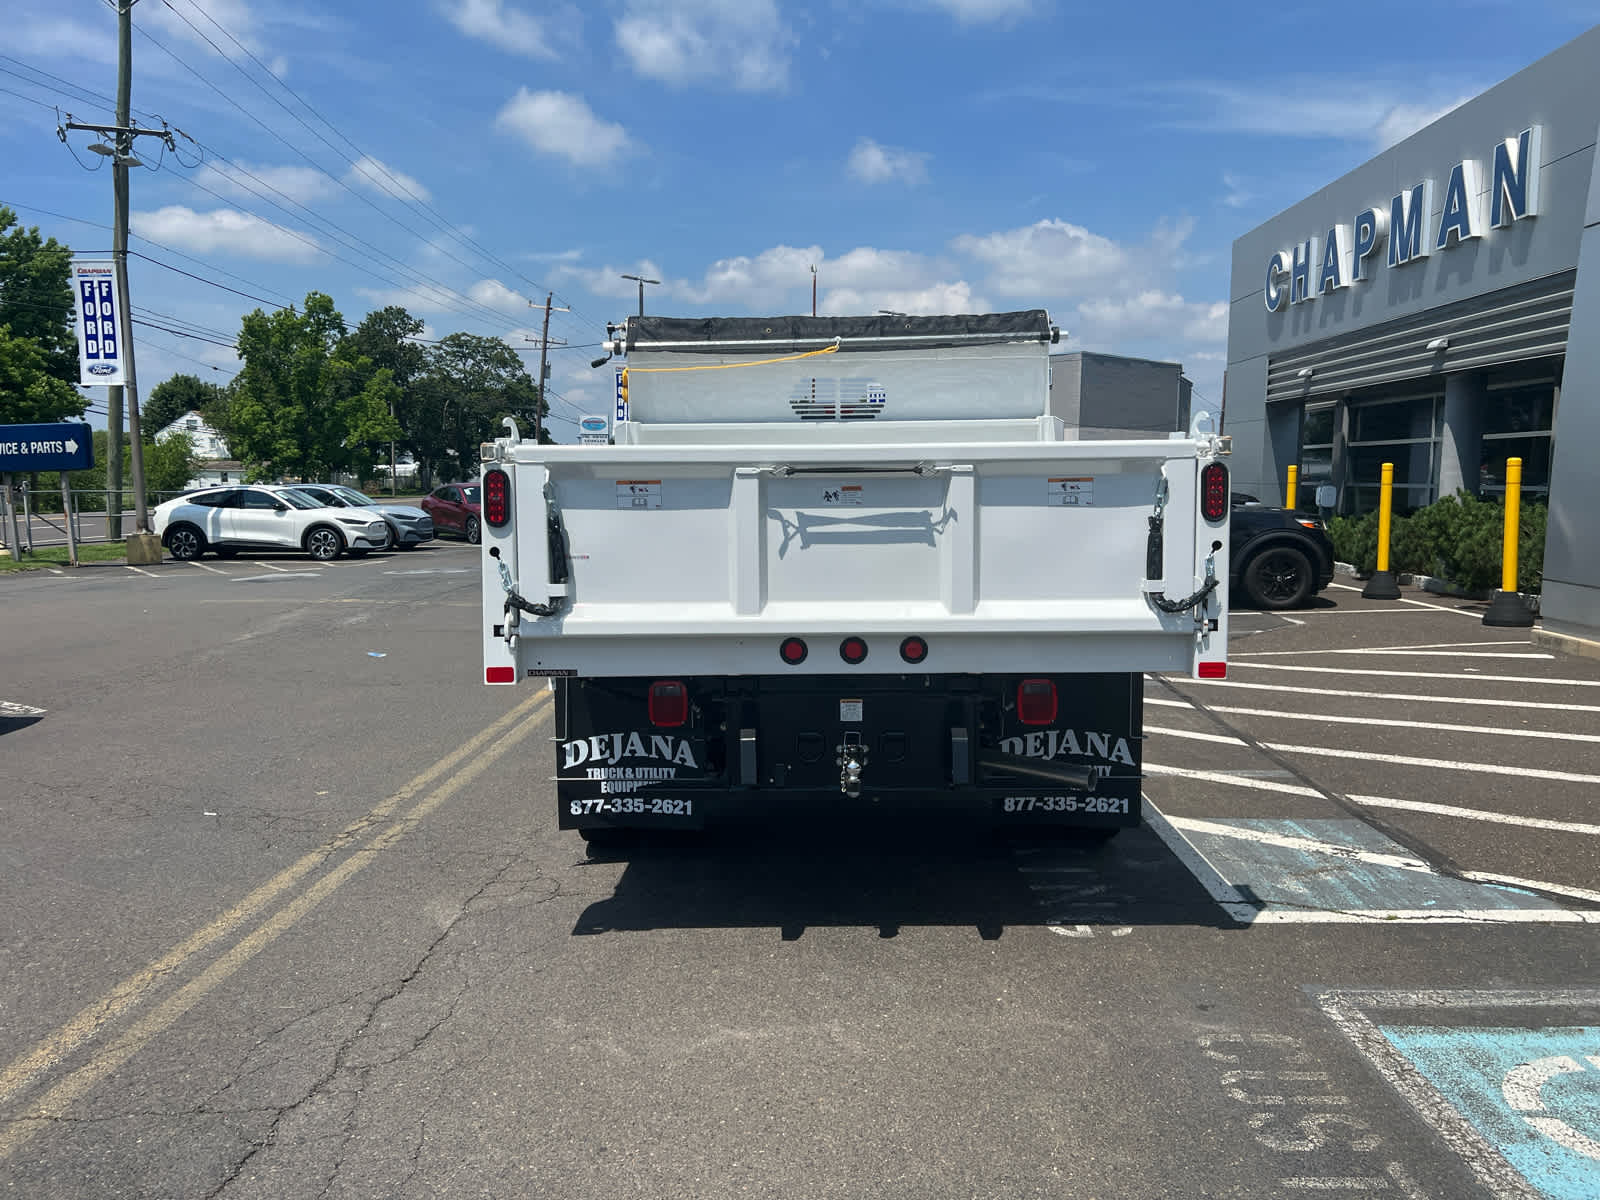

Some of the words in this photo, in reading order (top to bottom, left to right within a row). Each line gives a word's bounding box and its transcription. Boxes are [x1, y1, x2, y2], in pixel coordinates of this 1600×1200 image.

[1264, 124, 1543, 313] CHAPMAN
[83, 283, 98, 354] FORD
[101, 283, 115, 354] FORD
[20, 442, 29, 454] &
[30, 441, 64, 454] PARTS
[562, 731, 699, 770] DEJANA
[569, 798, 693, 816] 877-335-2621
[1003, 796, 1129, 814] 877-335-2621
